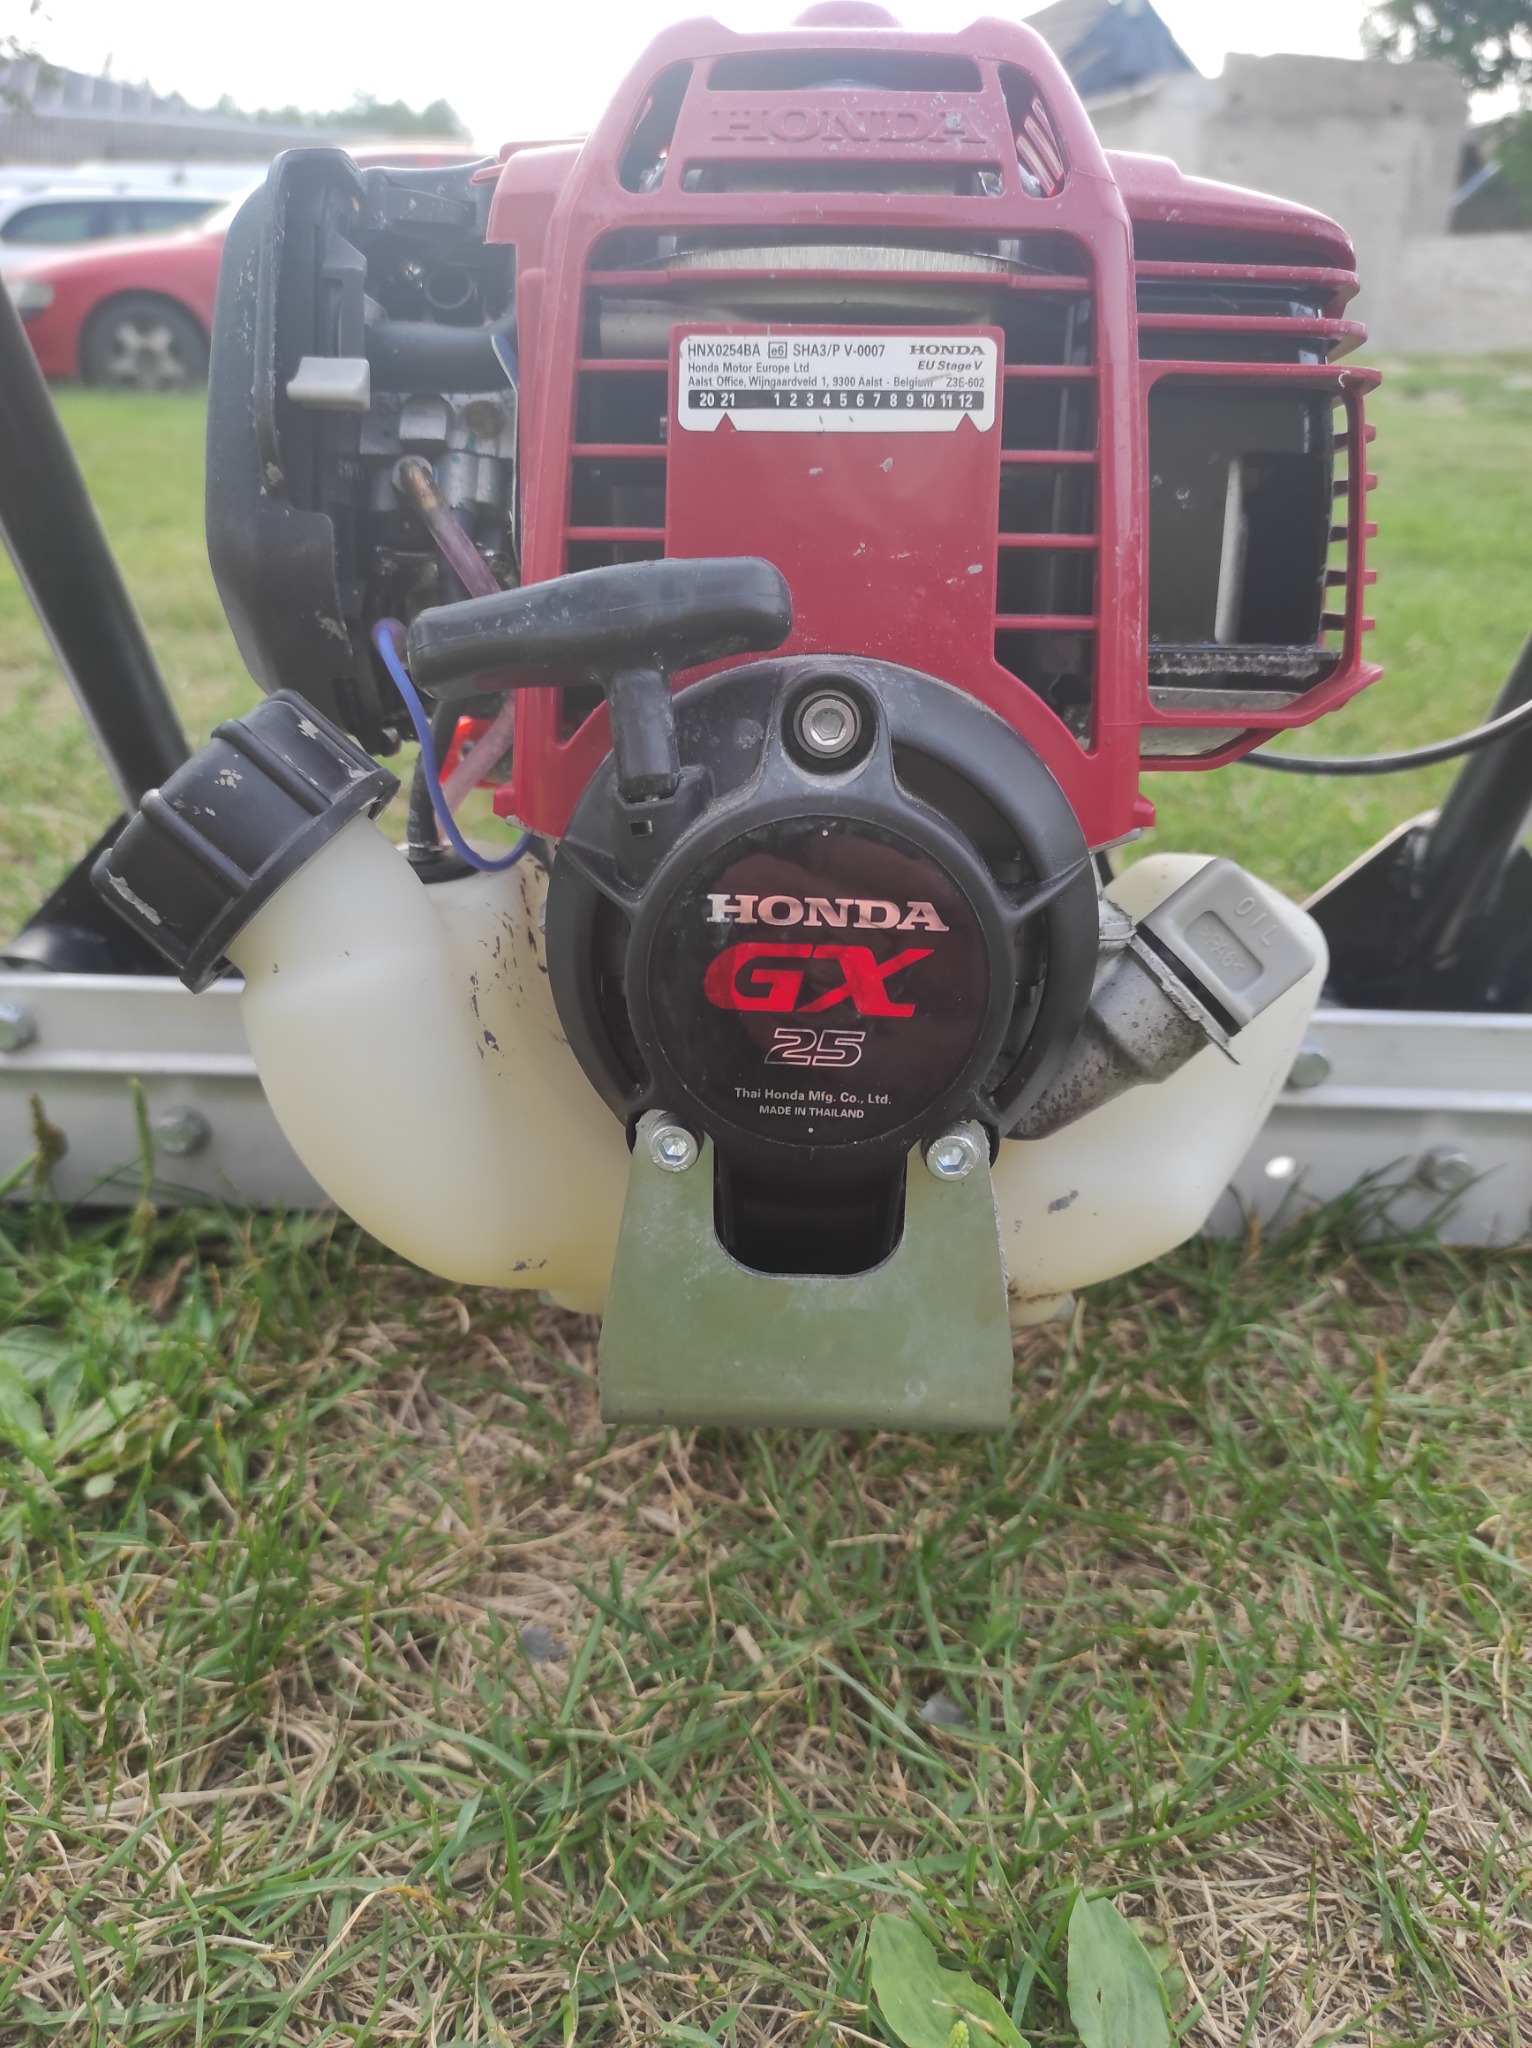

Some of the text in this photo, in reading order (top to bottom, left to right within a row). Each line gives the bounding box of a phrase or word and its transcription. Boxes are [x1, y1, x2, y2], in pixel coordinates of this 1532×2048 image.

[711, 109, 987, 144] HONDA
[688, 343, 885, 358] HNX0254BA e6 SHA3/P V-0007
[910, 345, 985, 355] HONDA
[688, 363, 810, 375] Honda Motor Europe Ltd
[917, 361, 983, 373] EU Stage V
[688, 377, 713, 387] Aalst
[716, 377, 747, 389] Office,
[749, 377, 818, 390] Wijngaardveld
[822, 378, 830, 389] 1,
[833, 378, 856, 388] 9300
[858, 377, 883, 388] Aalst
[893, 377, 934, 390] Belgium
[946, 378, 985, 388] Z3E-602
[699, 393, 973, 408] 20 21 1 2 3 4 5 6 7 8 9 10 11 12
[706, 893, 950, 932] HONDA
[1234, 896, 1277, 945] OIL
[703, 942, 935, 1018] GX
[763, 1027, 866, 1068] 25
[734, 1087, 892, 1105] Thai Honda Mfg. Co., Ltd.
[759, 1105, 865, 1119] MADE IN THAILAND
